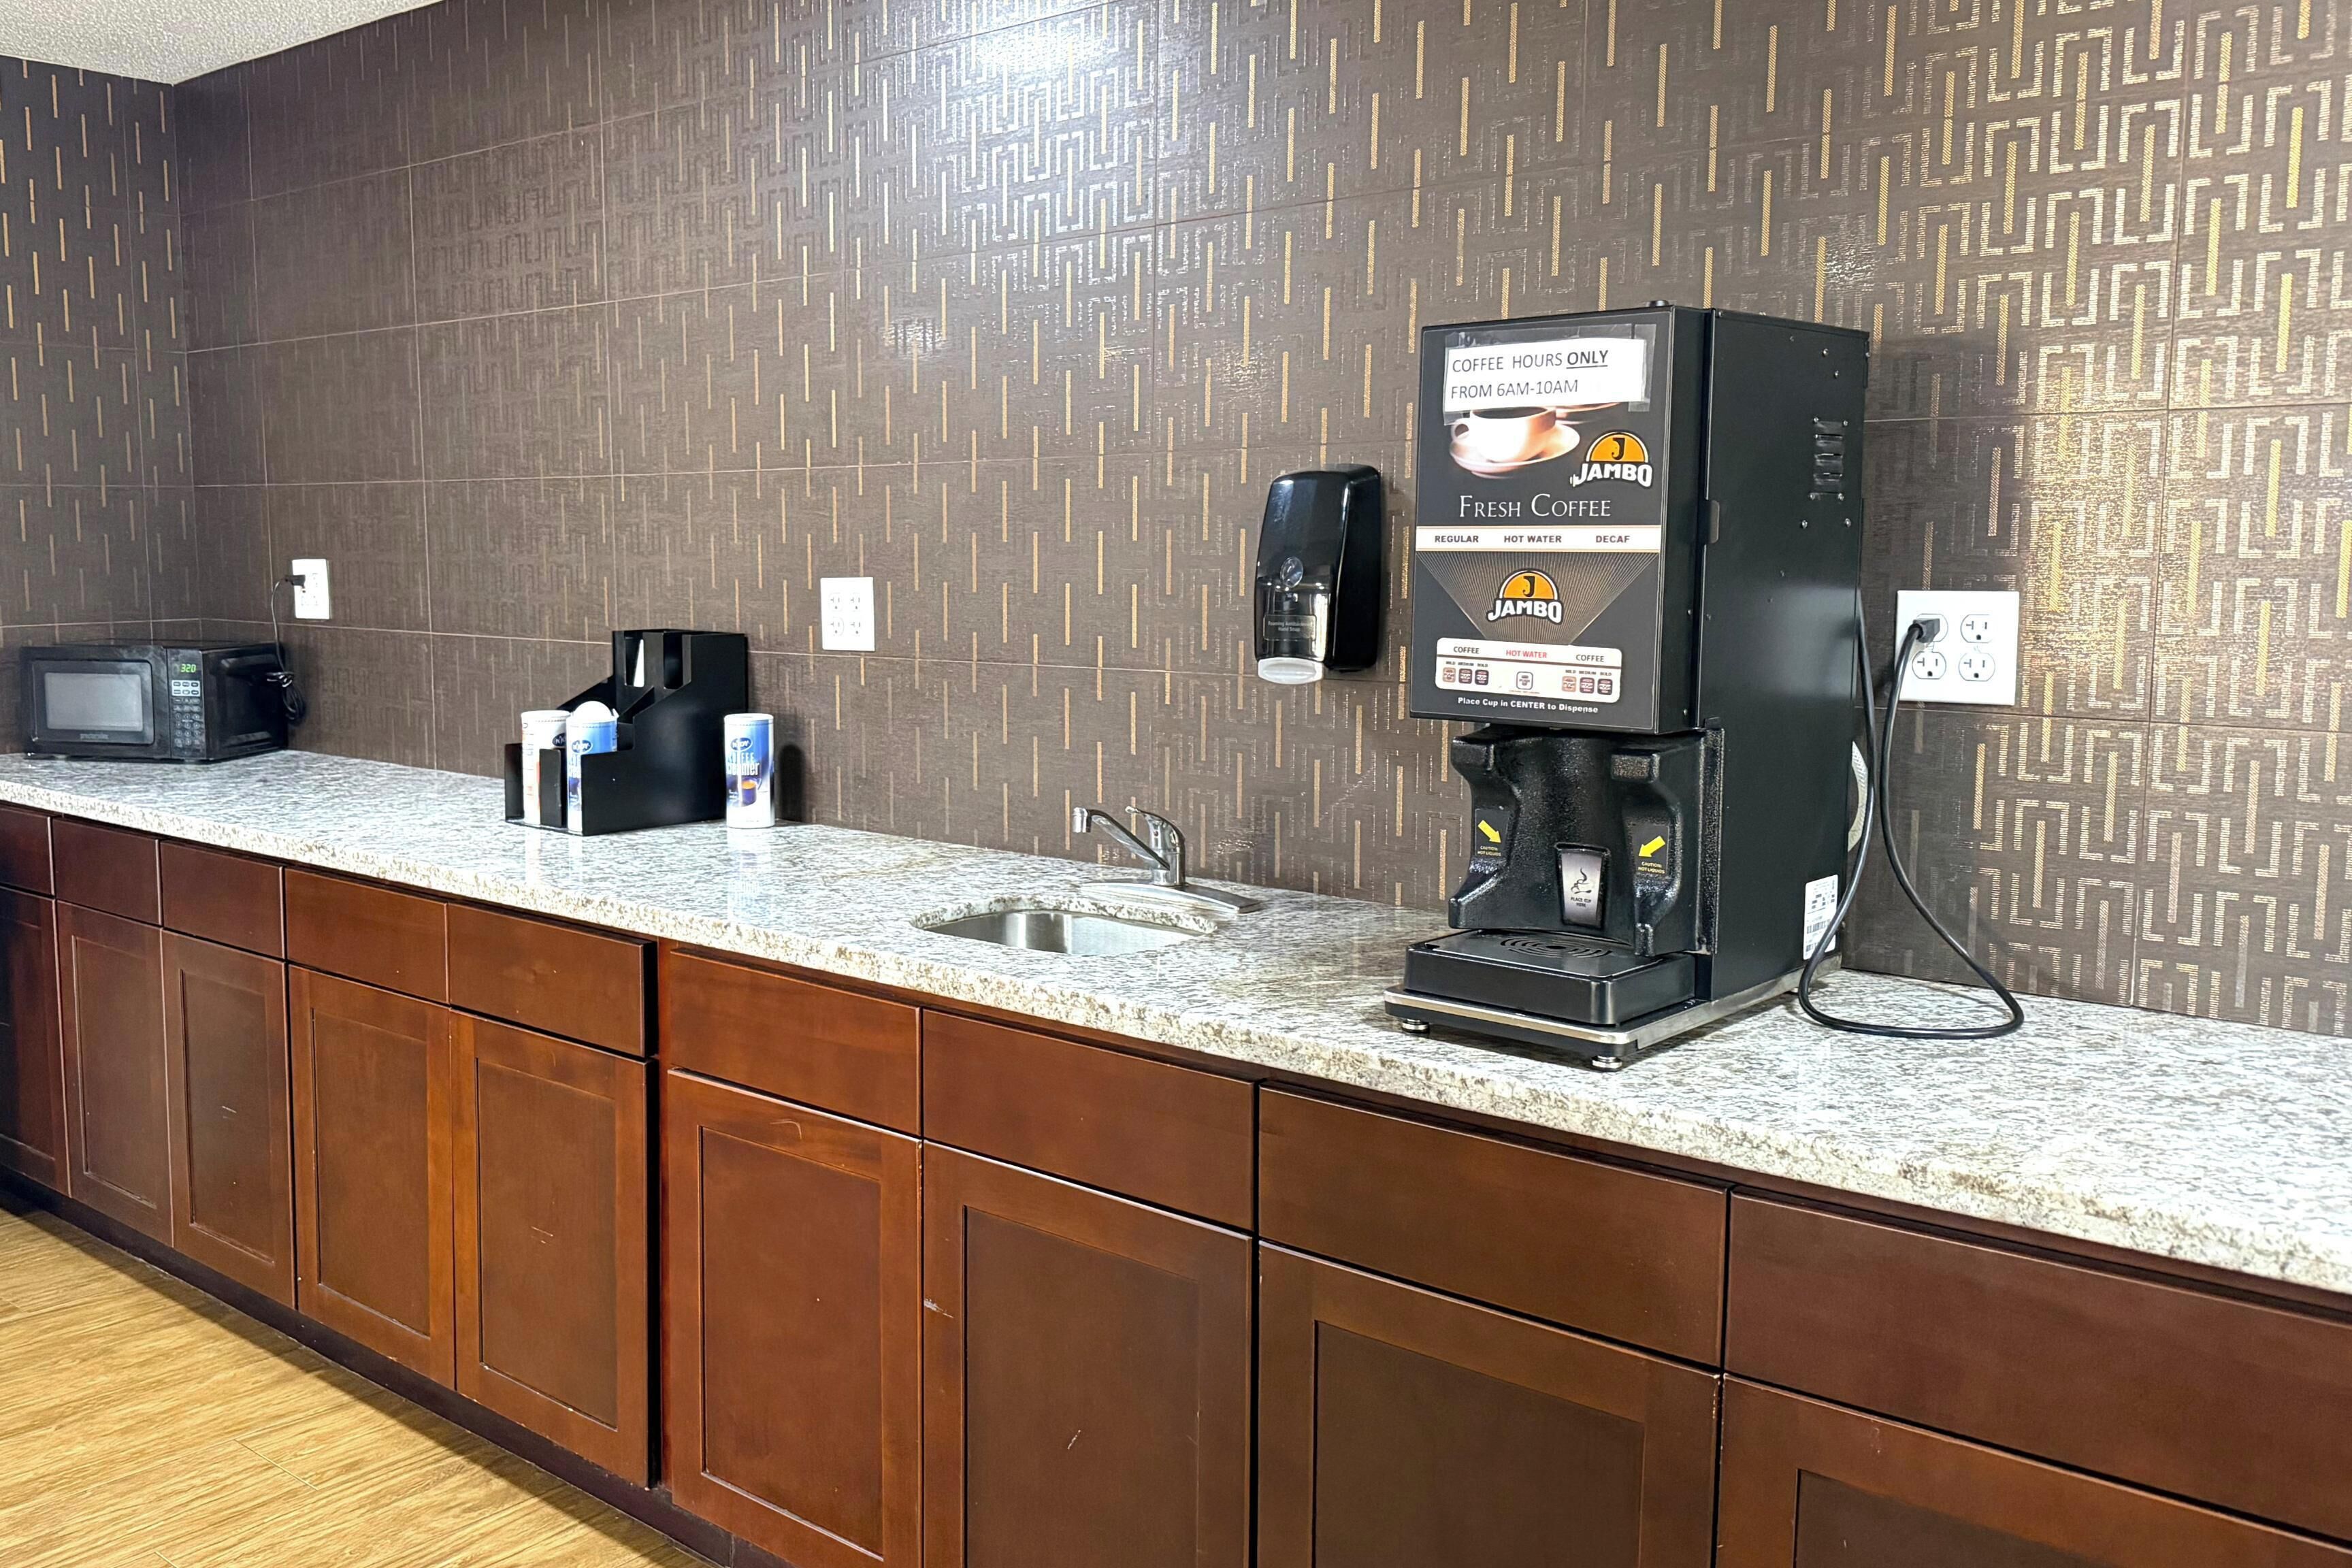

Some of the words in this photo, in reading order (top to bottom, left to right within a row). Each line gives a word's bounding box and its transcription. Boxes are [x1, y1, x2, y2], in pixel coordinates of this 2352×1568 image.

[1452, 356, 1504, 373] COFFEE
[1512, 352, 1563, 370] HOURS
[1566, 349, 1609, 369] ONLY
[1450, 383, 1492, 399] FROM
[1496, 379, 1578, 397] 6AM-10AM
[1611, 437, 1626, 459] J
[1569, 462, 1652, 487] JAMBO
[1459, 495, 1520, 518] FRESH
[1531, 493, 1611, 517] COFFEE
[1434, 535, 1480, 544] REGULAR
[1503, 535, 1524, 543] HOT
[1526, 535, 1562, 543] WATER
[1595, 535, 1630, 543] DECAF
[1522, 575, 1536, 598] J
[1487, 600, 1563, 623] JAMBO
[1453, 646, 1480, 654] COFFEE
[1505, 649, 1521, 657] HOT
[1522, 651, 1548, 659] WATER
[1575, 654, 1605, 663] COFFEE
[1458, 696, 1480, 705] Place
[1482, 698, 1499, 708] Cup
[1500, 699, 1508, 707] in
[1510, 700, 1546, 710] CENTER
[1558, 704, 1599, 713] Dispense
